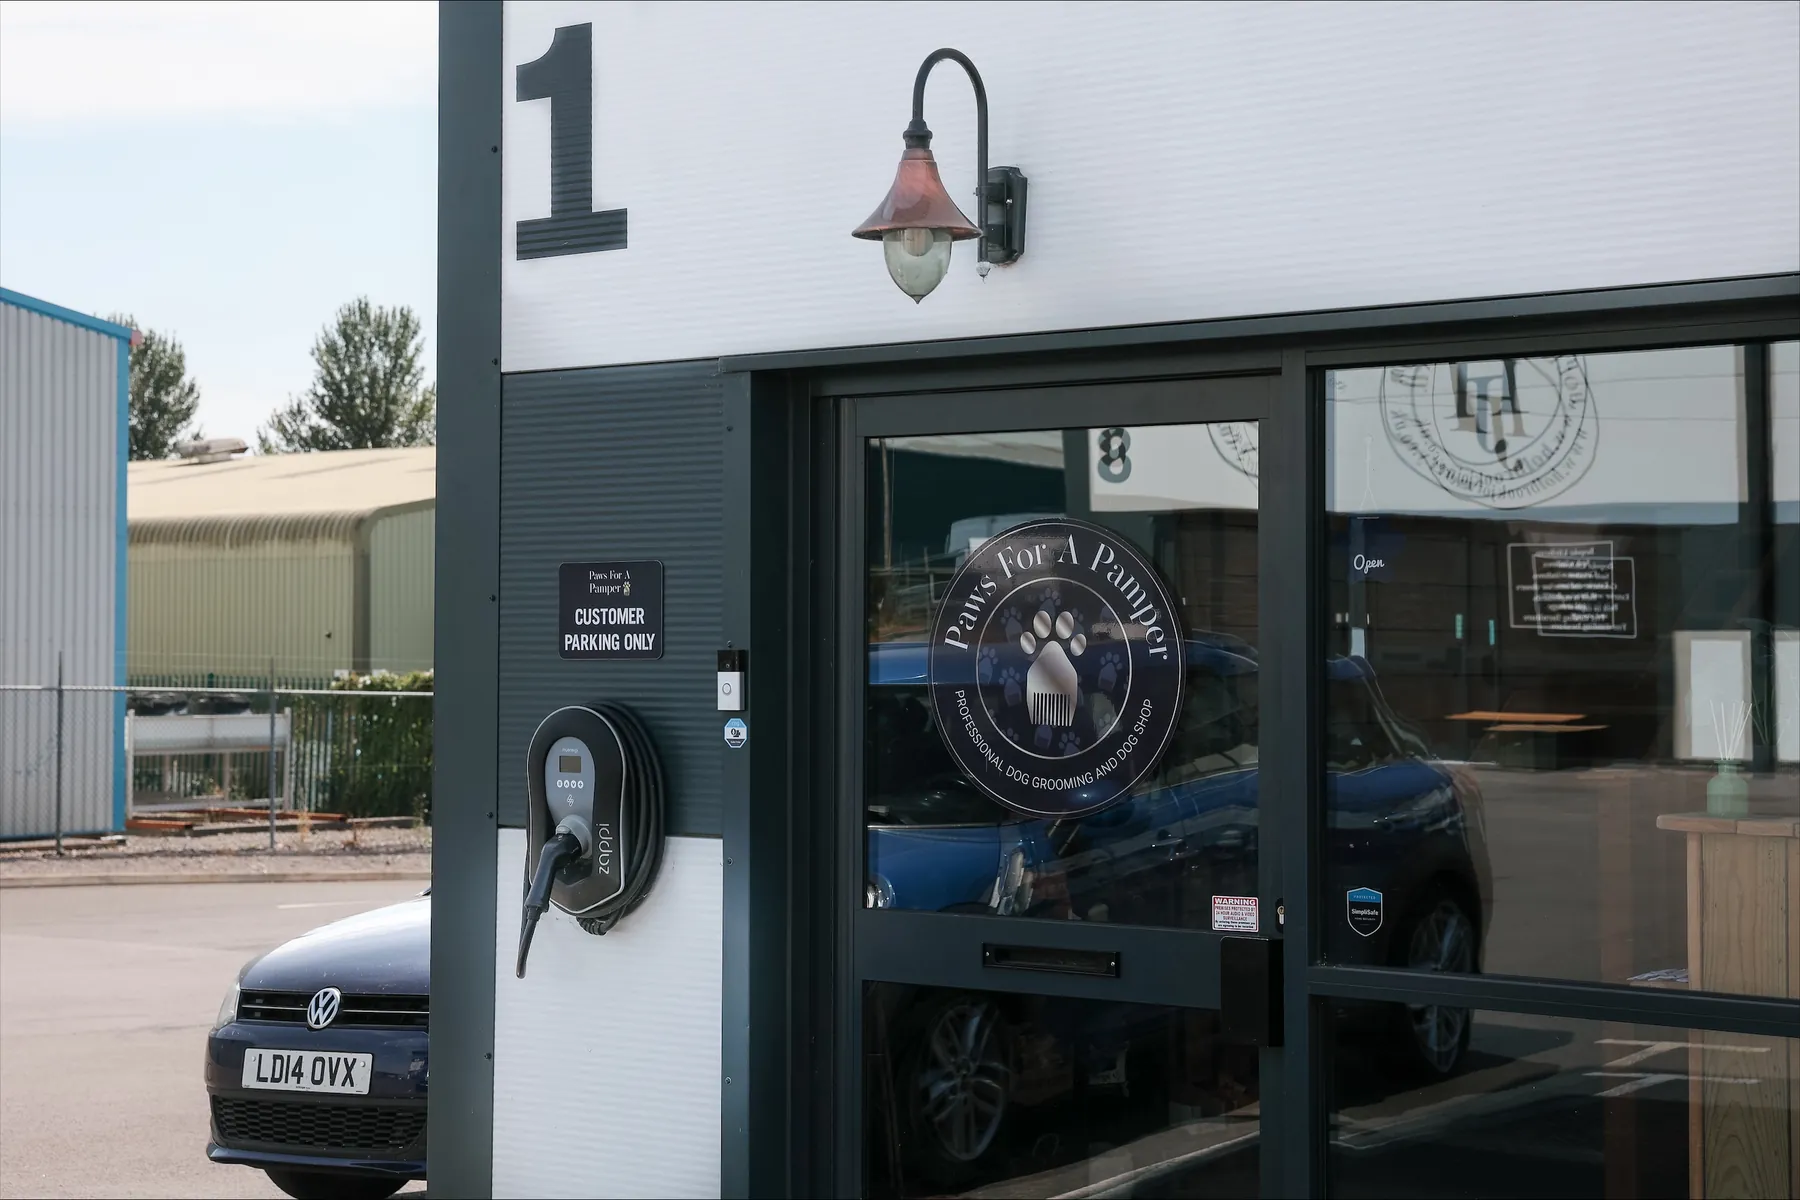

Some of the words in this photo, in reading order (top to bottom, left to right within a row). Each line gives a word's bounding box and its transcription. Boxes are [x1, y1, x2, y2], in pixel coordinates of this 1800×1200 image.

[516, 22, 627, 261] 1
[589, 570, 608, 581] Paws
[609, 570, 622, 580] For
[624, 570, 630, 580] A
[1353, 553, 1385, 574] Open
[589, 583, 621, 595] Pamper
[944, 574, 997, 650] Paws
[997, 543, 1047, 579] For
[1057, 534, 1080, 565] A
[1089, 541, 1168, 660] Pamper
[575, 607, 645, 625] CUSTOMER
[564, 633, 620, 651] PARKING
[624, 633, 655, 651] ONLY
[954, 689, 1004, 772] PROFESSIONAL
[1005, 766, 1030, 785] DOG
[1032, 771, 1094, 791] GROOMING
[1095, 756, 1118, 779] AND
[1116, 734, 1138, 762] DOG
[1133, 698, 1153, 735] SHOP
[596, 823, 613, 875] zappi
[256, 1053, 304, 1084] LD14
[310, 1056, 357, 1088] OVX
